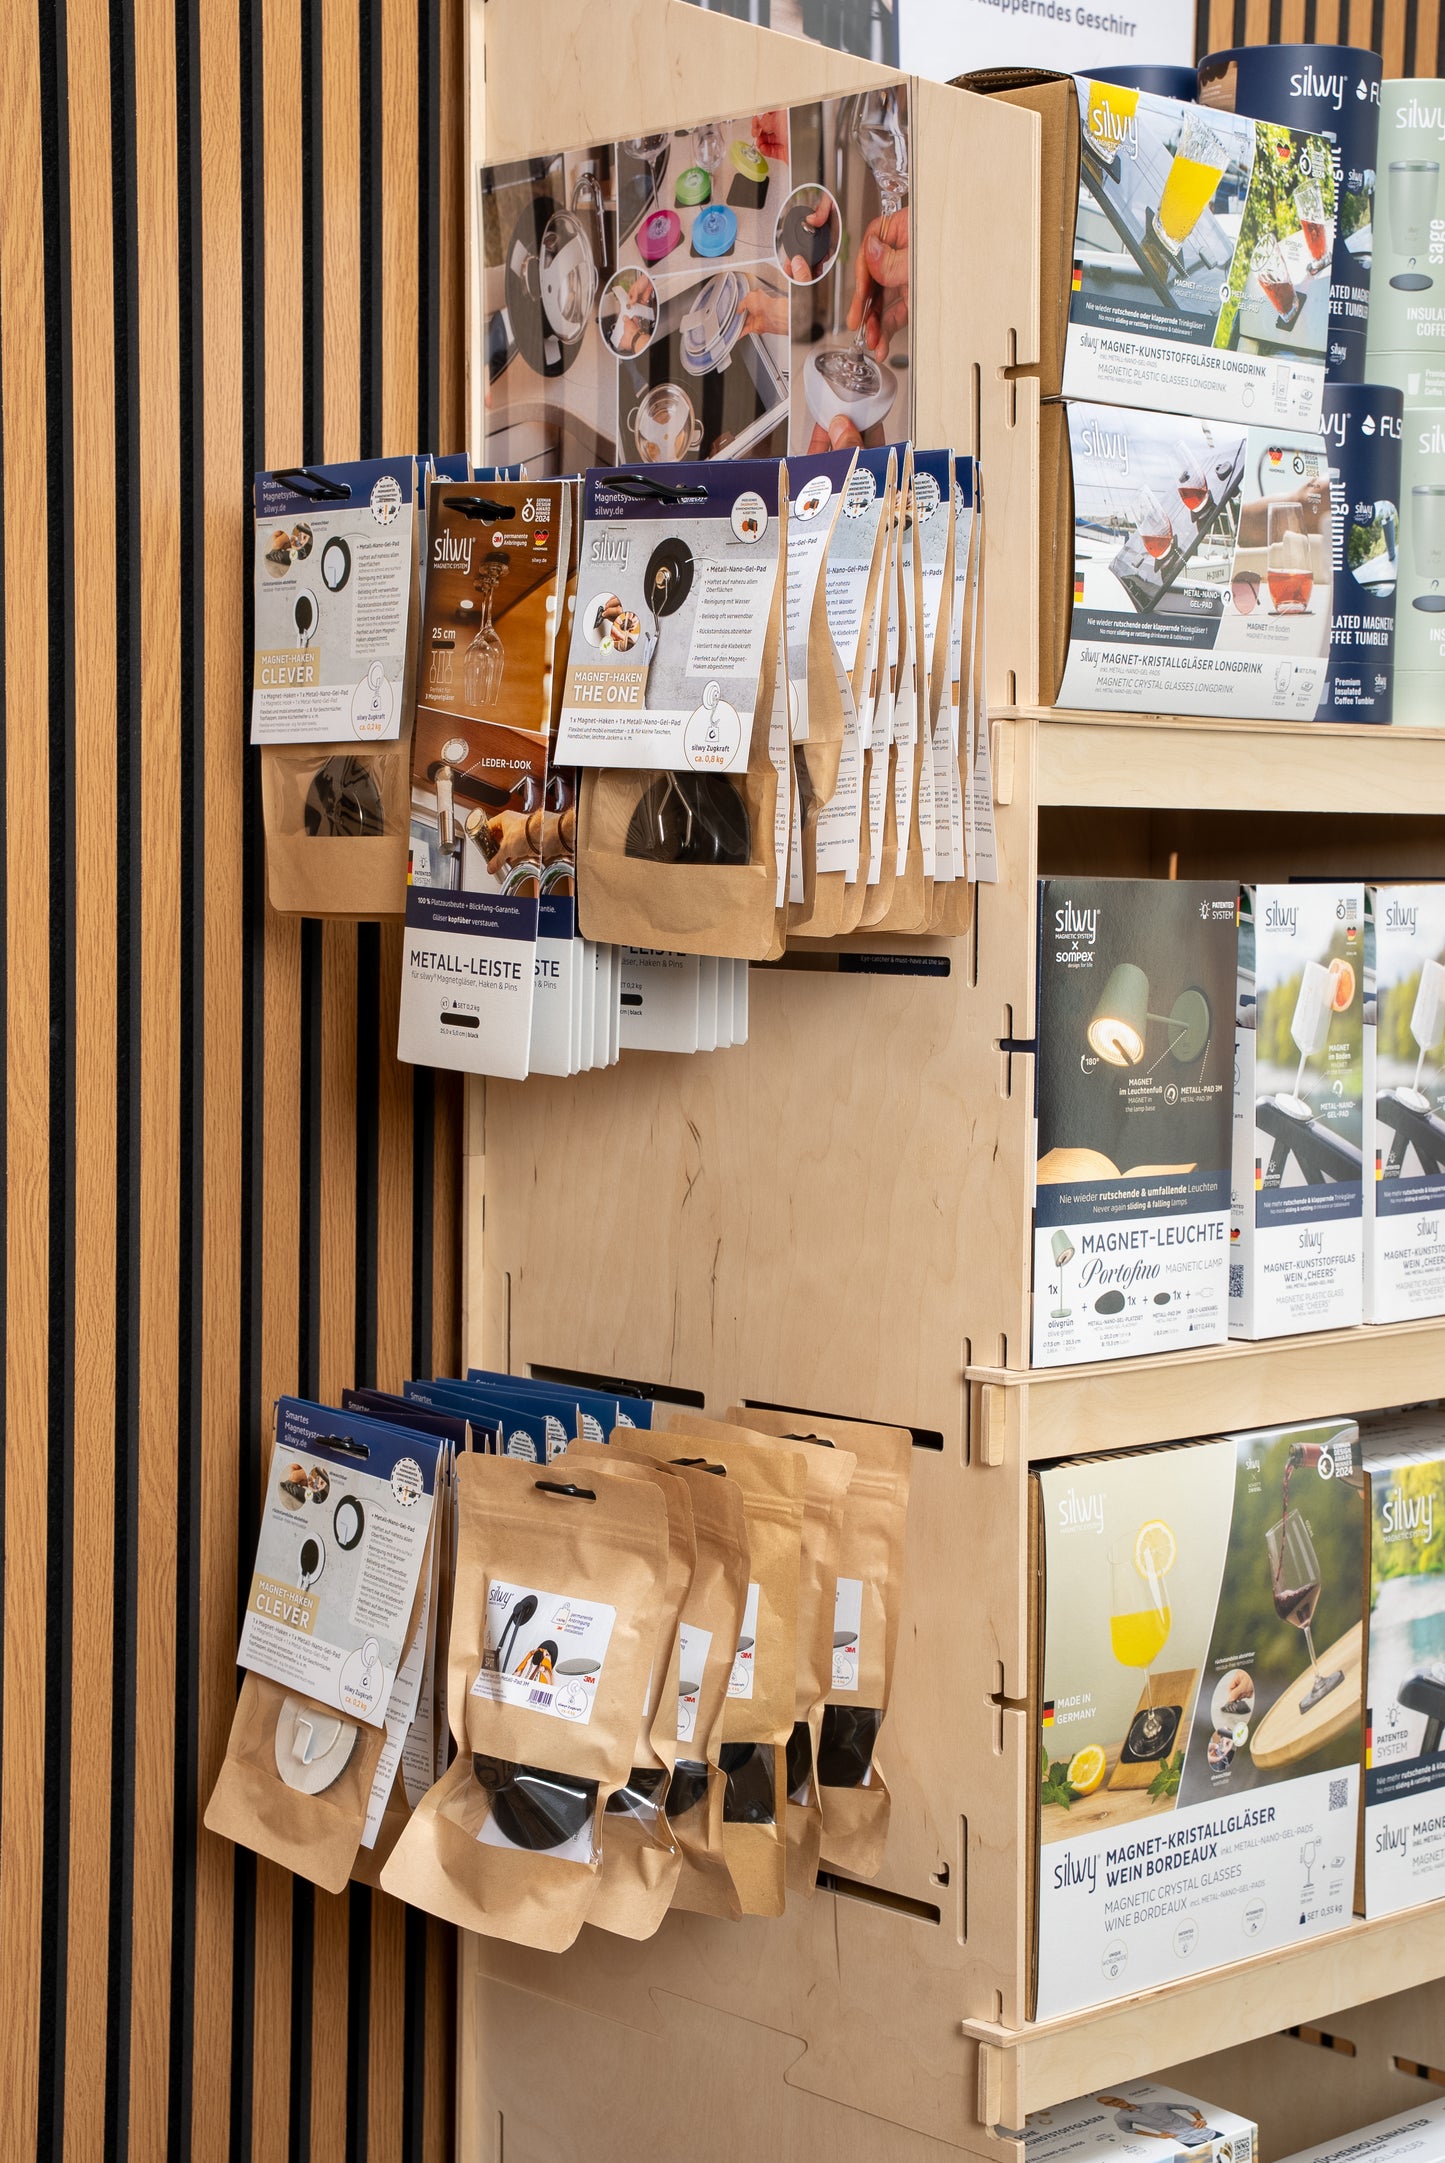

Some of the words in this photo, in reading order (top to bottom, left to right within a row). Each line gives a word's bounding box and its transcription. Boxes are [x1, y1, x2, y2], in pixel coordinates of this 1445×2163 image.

[1076, 7, 1136, 37] Geschirr
[1428, 219, 1444, 264] sage
[1085, 302, 1094, 310] Nie
[1095, 304, 1111, 313] wieder
[1112, 306, 1139, 318] rutschende
[1140, 311, 1151, 320] oder
[1151, 313, 1178, 325] klappernde
[1100, 339, 1221, 370] MAGNET-KUNSTSTOFFGLÄSER
[1222, 359, 1266, 377] LONGDRINK
[1098, 364, 1132, 377] MAGNETIC
[1134, 369, 1160, 382] PLASTIC
[1161, 373, 1189, 386] GLASSES
[1190, 379, 1227, 393] LONGDRINK
[264, 505, 286, 513] silwy.de
[595, 506, 624, 516] silwy.de
[534, 515, 550, 523] 2024
[710, 565, 766, 573] Metall-Nano-Gel-Pad
[704, 598, 723, 606] Reinigung
[1190, 601, 1212, 610] GEL-PAD
[702, 613, 718, 621] Beliebig
[1363, 616, 1394, 631] MAGNETIC
[1096, 619, 1113, 627] wieder
[1114, 620, 1141, 630] rutschende
[1153, 623, 1180, 633] klappernde
[432, 628, 442, 639] 25
[443, 630, 456, 639] cm
[1355, 632, 1388, 646] TUMBLER
[696, 642, 714, 650] Verliert
[261, 653, 315, 665] MAGNET-HAKEN
[694, 655, 710, 663] Perfekt
[1102, 652, 1213, 671] MAGNET-KRISTALLGLÄSER
[1215, 661, 1263, 674] LONGDRINK
[707, 663, 735, 671] abgestimmt
[261, 666, 314, 685] CLEVER
[574, 671, 642, 683] MAGNET-HAKEN
[1335, 678, 1361, 686] Premium
[1096, 676, 1134, 687] MAGNETIC
[1135, 679, 1163, 690] CRYSTAL
[1164, 681, 1194, 692] GLASSES
[1195, 683, 1234, 694] LONGDRINK
[1335, 687, 1361, 695] Insulated
[574, 685, 602, 702] THE
[607, 686, 639, 703] ONE
[1335, 697, 1353, 705] Coffee
[1355, 697, 1375, 705] Tumbler
[368, 713, 385, 721] Zugkraft
[577, 717, 615, 726] Magnet-Haken
[626, 718, 681, 726] Metall-Nano-Gel-Pad
[691, 745, 705, 753] silwy
[706, 744, 729, 753] Zugkraft
[482, 758, 532, 770] LEDER-LOOK
[695, 755, 703, 763] ca.
[704, 755, 715, 763] 0,8
[716, 756, 724, 765] kg
[431, 898, 465, 909] Platzausbeute
[469, 902, 520, 914] Blickfang-Garantie.
[432, 913, 447, 921] Gläser
[448, 915, 471, 925] kopfüber
[472, 919, 499, 928] verstauen.
[1212, 911, 1234, 920] SYSTEM
[1265, 900, 1297, 936] silwy
[1386, 900, 1417, 935] silwy
[1056, 951, 1093, 962] sompex
[410, 950, 521, 979] METALL-LEISTE
[437, 975, 477, 987] Magnetgläser,
[479, 980, 497, 989] Haken
[505, 983, 518, 991] Pins
[544, 981, 557, 989] Pins
[1329, 1044, 1350, 1052] MAGNET
[1129, 1078, 1152, 1086] MAGNET
[1128, 1087, 1162, 1095] Leuchtenfuß
[1181, 1086, 1215, 1094] METALL-PAD
[1327, 1110, 1349, 1118] GEL-PAD
[1060, 1195, 1072, 1204] Nie
[1073, 1193, 1098, 1204] wieder
[1100, 1190, 1140, 1201] rutschende
[1141, 1189, 1146, 1197] &
[1148, 1185, 1186, 1197] umfallende
[1188, 1183, 1217, 1193] Leuchten
[1111, 1205, 1126, 1213] again
[1127, 1201, 1146, 1211] sliding
[1152, 1199, 1170, 1209] falling
[1082, 1222, 1224, 1254] MAGNET-LEUCHTE
[1264, 1254, 1355, 1273] MAGNET-KUNSTSTOFFGLAS
[1079, 1258, 1160, 1289] Portofino
[1166, 1259, 1202, 1273] MAGNETIC
[1203, 1258, 1223, 1269] LAMP
[1284, 1272, 1302, 1282] WEIN
[1049, 1285, 1058, 1295] 1x
[1173, 1291, 1181, 1300] 1x
[1127, 1296, 1136, 1305] 1x
[1048, 1319, 1074, 1329] olivgrün
[285, 1410, 309, 1425] Smartes
[284, 1434, 307, 1448] silwy.de
[1335, 1467, 1353, 1478] 2024
[259, 1580, 313, 1608] MAGNET-HAKEN
[256, 1593, 310, 1629] CLEVER
[583, 1675, 595, 1684] 3M
[355, 1688, 373, 1701] Zugkraft
[1058, 1695, 1080, 1709] MADE
[1082, 1692, 1091, 1703] IN
[1057, 1707, 1097, 1725] GERMANY
[1377, 1730, 1408, 1744] PATENTED
[1377, 1741, 1408, 1758] SYSTEM
[1377, 1776, 1386, 1785] Nie
[1401, 1766, 1431, 1780] rutschende
[1106, 1806, 1276, 1867] MAGNET-KRISTALLGLÄSER
[1376, 1824, 1407, 1857] silwy
[1106, 1863, 1142, 1887] WEIN
[1146, 1842, 1218, 1877] BORDEAUX
[1104, 1889, 1156, 1915] MAGNETIC
[1157, 1877, 1199, 1902] CRYSTAL
[1200, 1864, 1242, 1887] GLASSES
[1104, 1914, 1131, 1932] WINE
[1134, 1898, 1187, 1924] BORDEAUX
[1307, 1910, 1318, 1920] SET
[1335, 1904, 1343, 1914] kg
